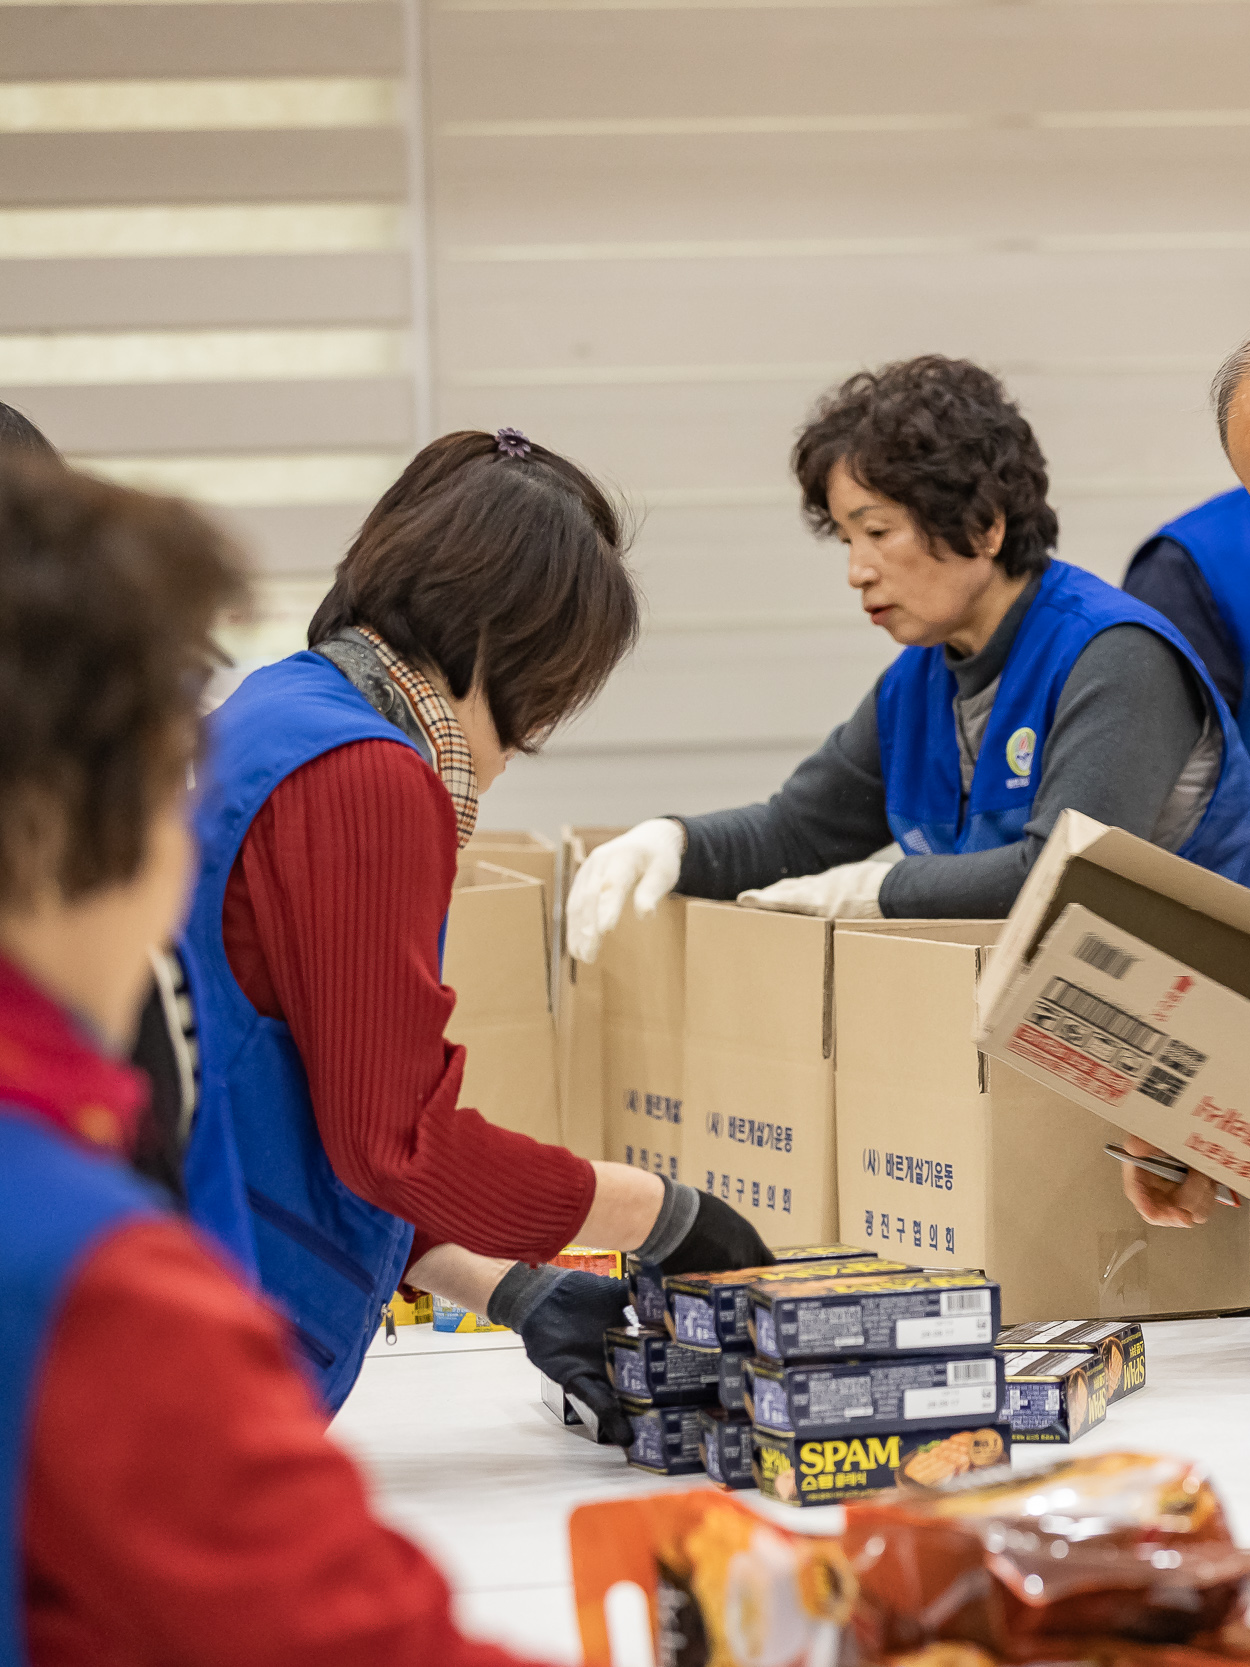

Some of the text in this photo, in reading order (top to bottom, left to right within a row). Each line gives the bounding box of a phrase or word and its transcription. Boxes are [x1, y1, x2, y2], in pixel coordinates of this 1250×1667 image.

[863, 1148, 954, 1191] (사) 바르게살기운동
[1123, 1356, 1146, 1392] SPAM
[800, 1436, 900, 1475] SPAM
